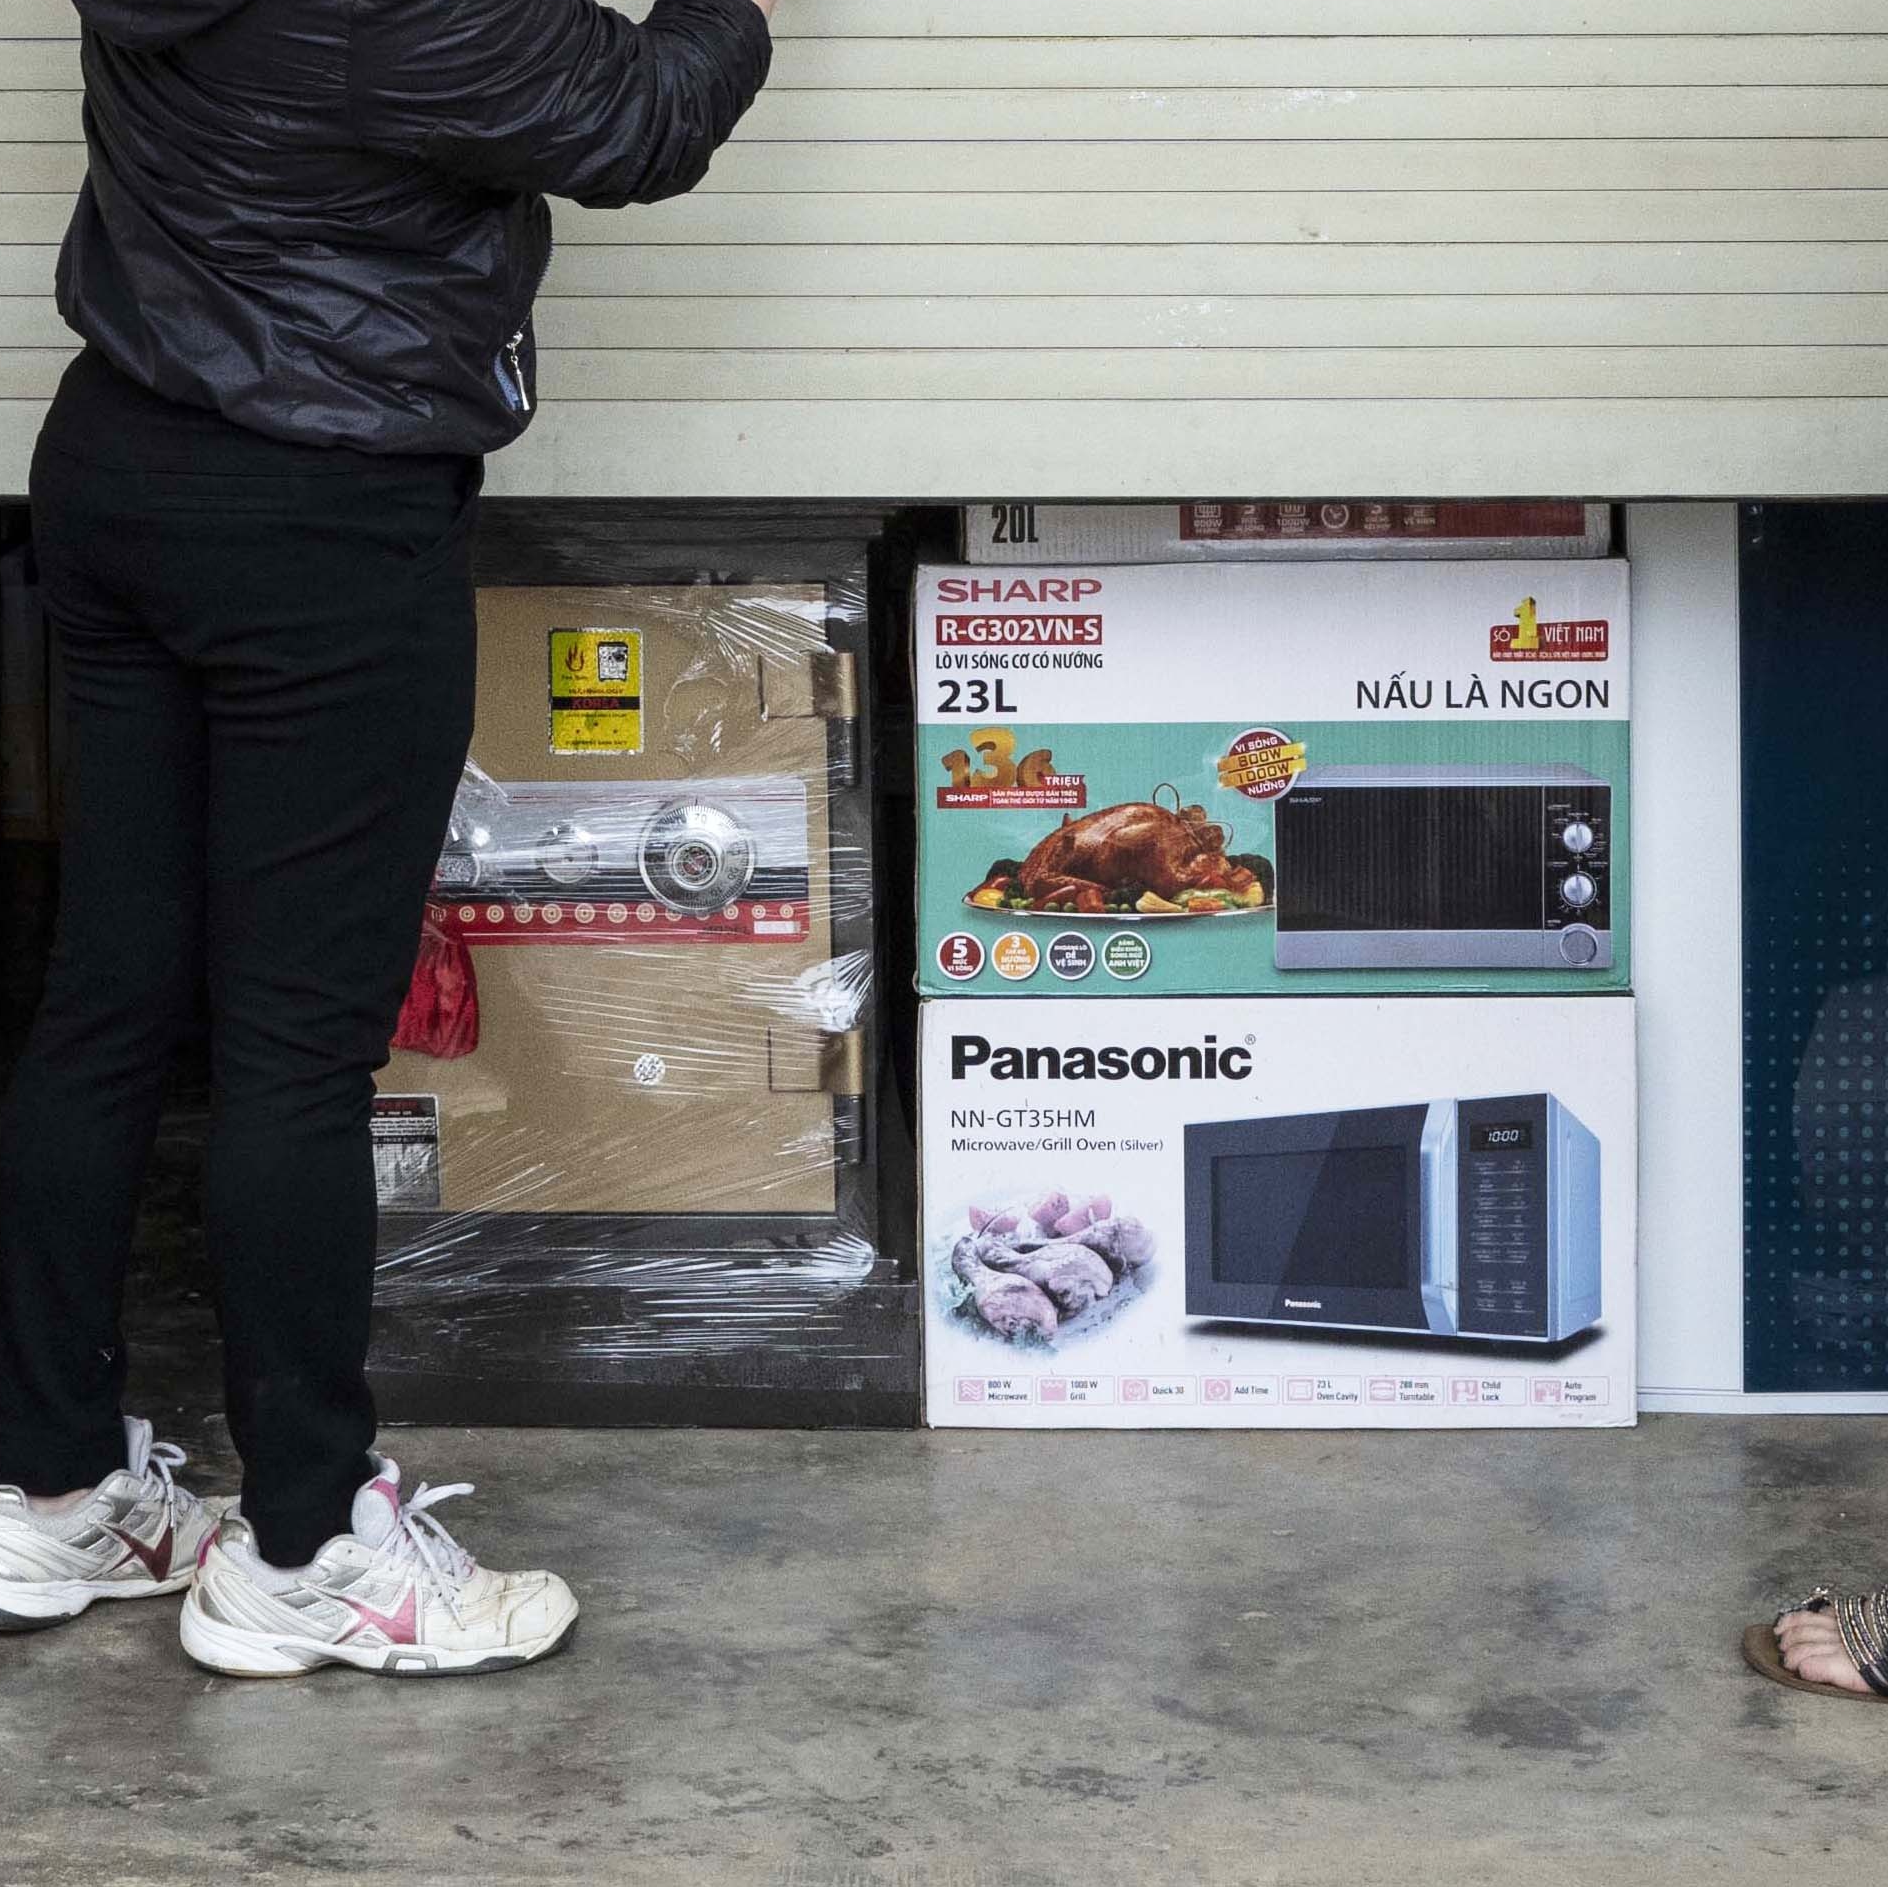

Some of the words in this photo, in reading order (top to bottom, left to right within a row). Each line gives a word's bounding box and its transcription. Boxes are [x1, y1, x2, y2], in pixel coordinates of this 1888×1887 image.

[937, 579, 1102, 602] SHARP
[941, 619, 1099, 642] R-G302VN-S
[1544, 623, 1570, 645] VIỆT
[1576, 626, 1604, 642] NAM
[936, 651, 952, 669] LÒ
[955, 656, 968, 669] VI
[971, 652, 1009, 669] SÓNG
[1013, 652, 1031, 669] CƠ
[1033, 652, 1050, 669] CÓ
[1053, 652, 1103, 669] NƯỚNG
[937, 679, 1018, 713] 23L
[1357, 670, 1433, 709] NẤU
[1445, 673, 1489, 709] LÀ
[1500, 679, 1609, 709] NGON
[1235, 744, 1245, 753] VI
[1248, 736, 1278, 751] SÓNG
[1238, 748, 1282, 768] 800W
[1239, 762, 1289, 784] 1000W
[1044, 776, 1080, 788] TRIỆU
[946, 794, 989, 802] SHARP
[953, 939, 967, 958] 5
[951, 1035, 1253, 1080] Panasonic
[951, 1109, 1096, 1128] NN-GT35HM
[1488, 1129, 1519, 1142] 10:00
[951, 1136, 1072, 1152] Microwave/Grill
[1076, 1137, 1116, 1152] Oven
[1119, 1138, 1163, 1153] (Silver)
[1285, 1299, 1321, 1309] Panasonic
[1152, 1386, 1172, 1395] Quick
[1234, 1386, 1248, 1394] Add
[1251, 1386, 1269, 1394] Time
[1481, 1381, 1501, 1390] Child
[1564, 1381, 1582, 1390] Auto
[988, 1392, 1027, 1401] Microwave
[1071, 1392, 1086, 1401] Grill
[1317, 1392, 1333, 1401] Oven
[1336, 1392, 1358, 1402] Cavity
[1399, 1393, 1435, 1401] Turntable
[1482, 1393, 1499, 1402] Lock
[1564, 1393, 1596, 1403] Program
